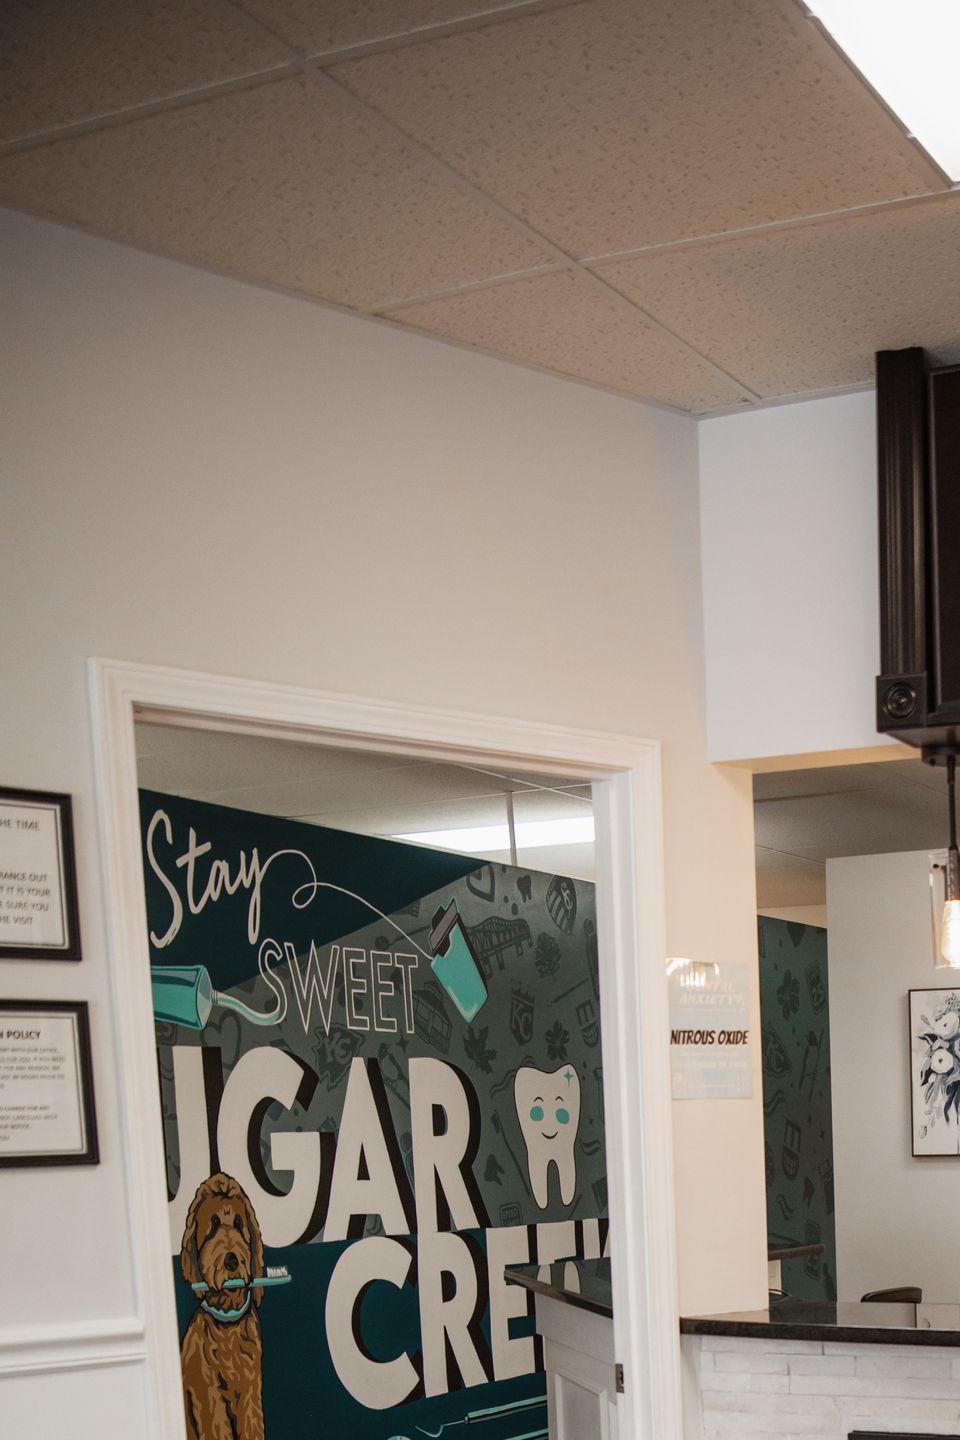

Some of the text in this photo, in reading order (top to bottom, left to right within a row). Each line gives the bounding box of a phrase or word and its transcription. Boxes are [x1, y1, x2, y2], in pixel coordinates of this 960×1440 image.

[15, 819, 40, 832] TIME
[28, 873, 48, 883] OUT
[146, 808, 268, 949] Stay
[27, 888, 51, 898] YOUR
[31, 902, 50, 912] YOU
[13, 916, 34, 926] VISIT
[257, 936, 419, 1036] SWEET
[6, 1029, 42, 1040] POLICY
[669, 1029, 750, 1046] NITROUS OXIDE
[323, 1218, 612, 1411] CRE
